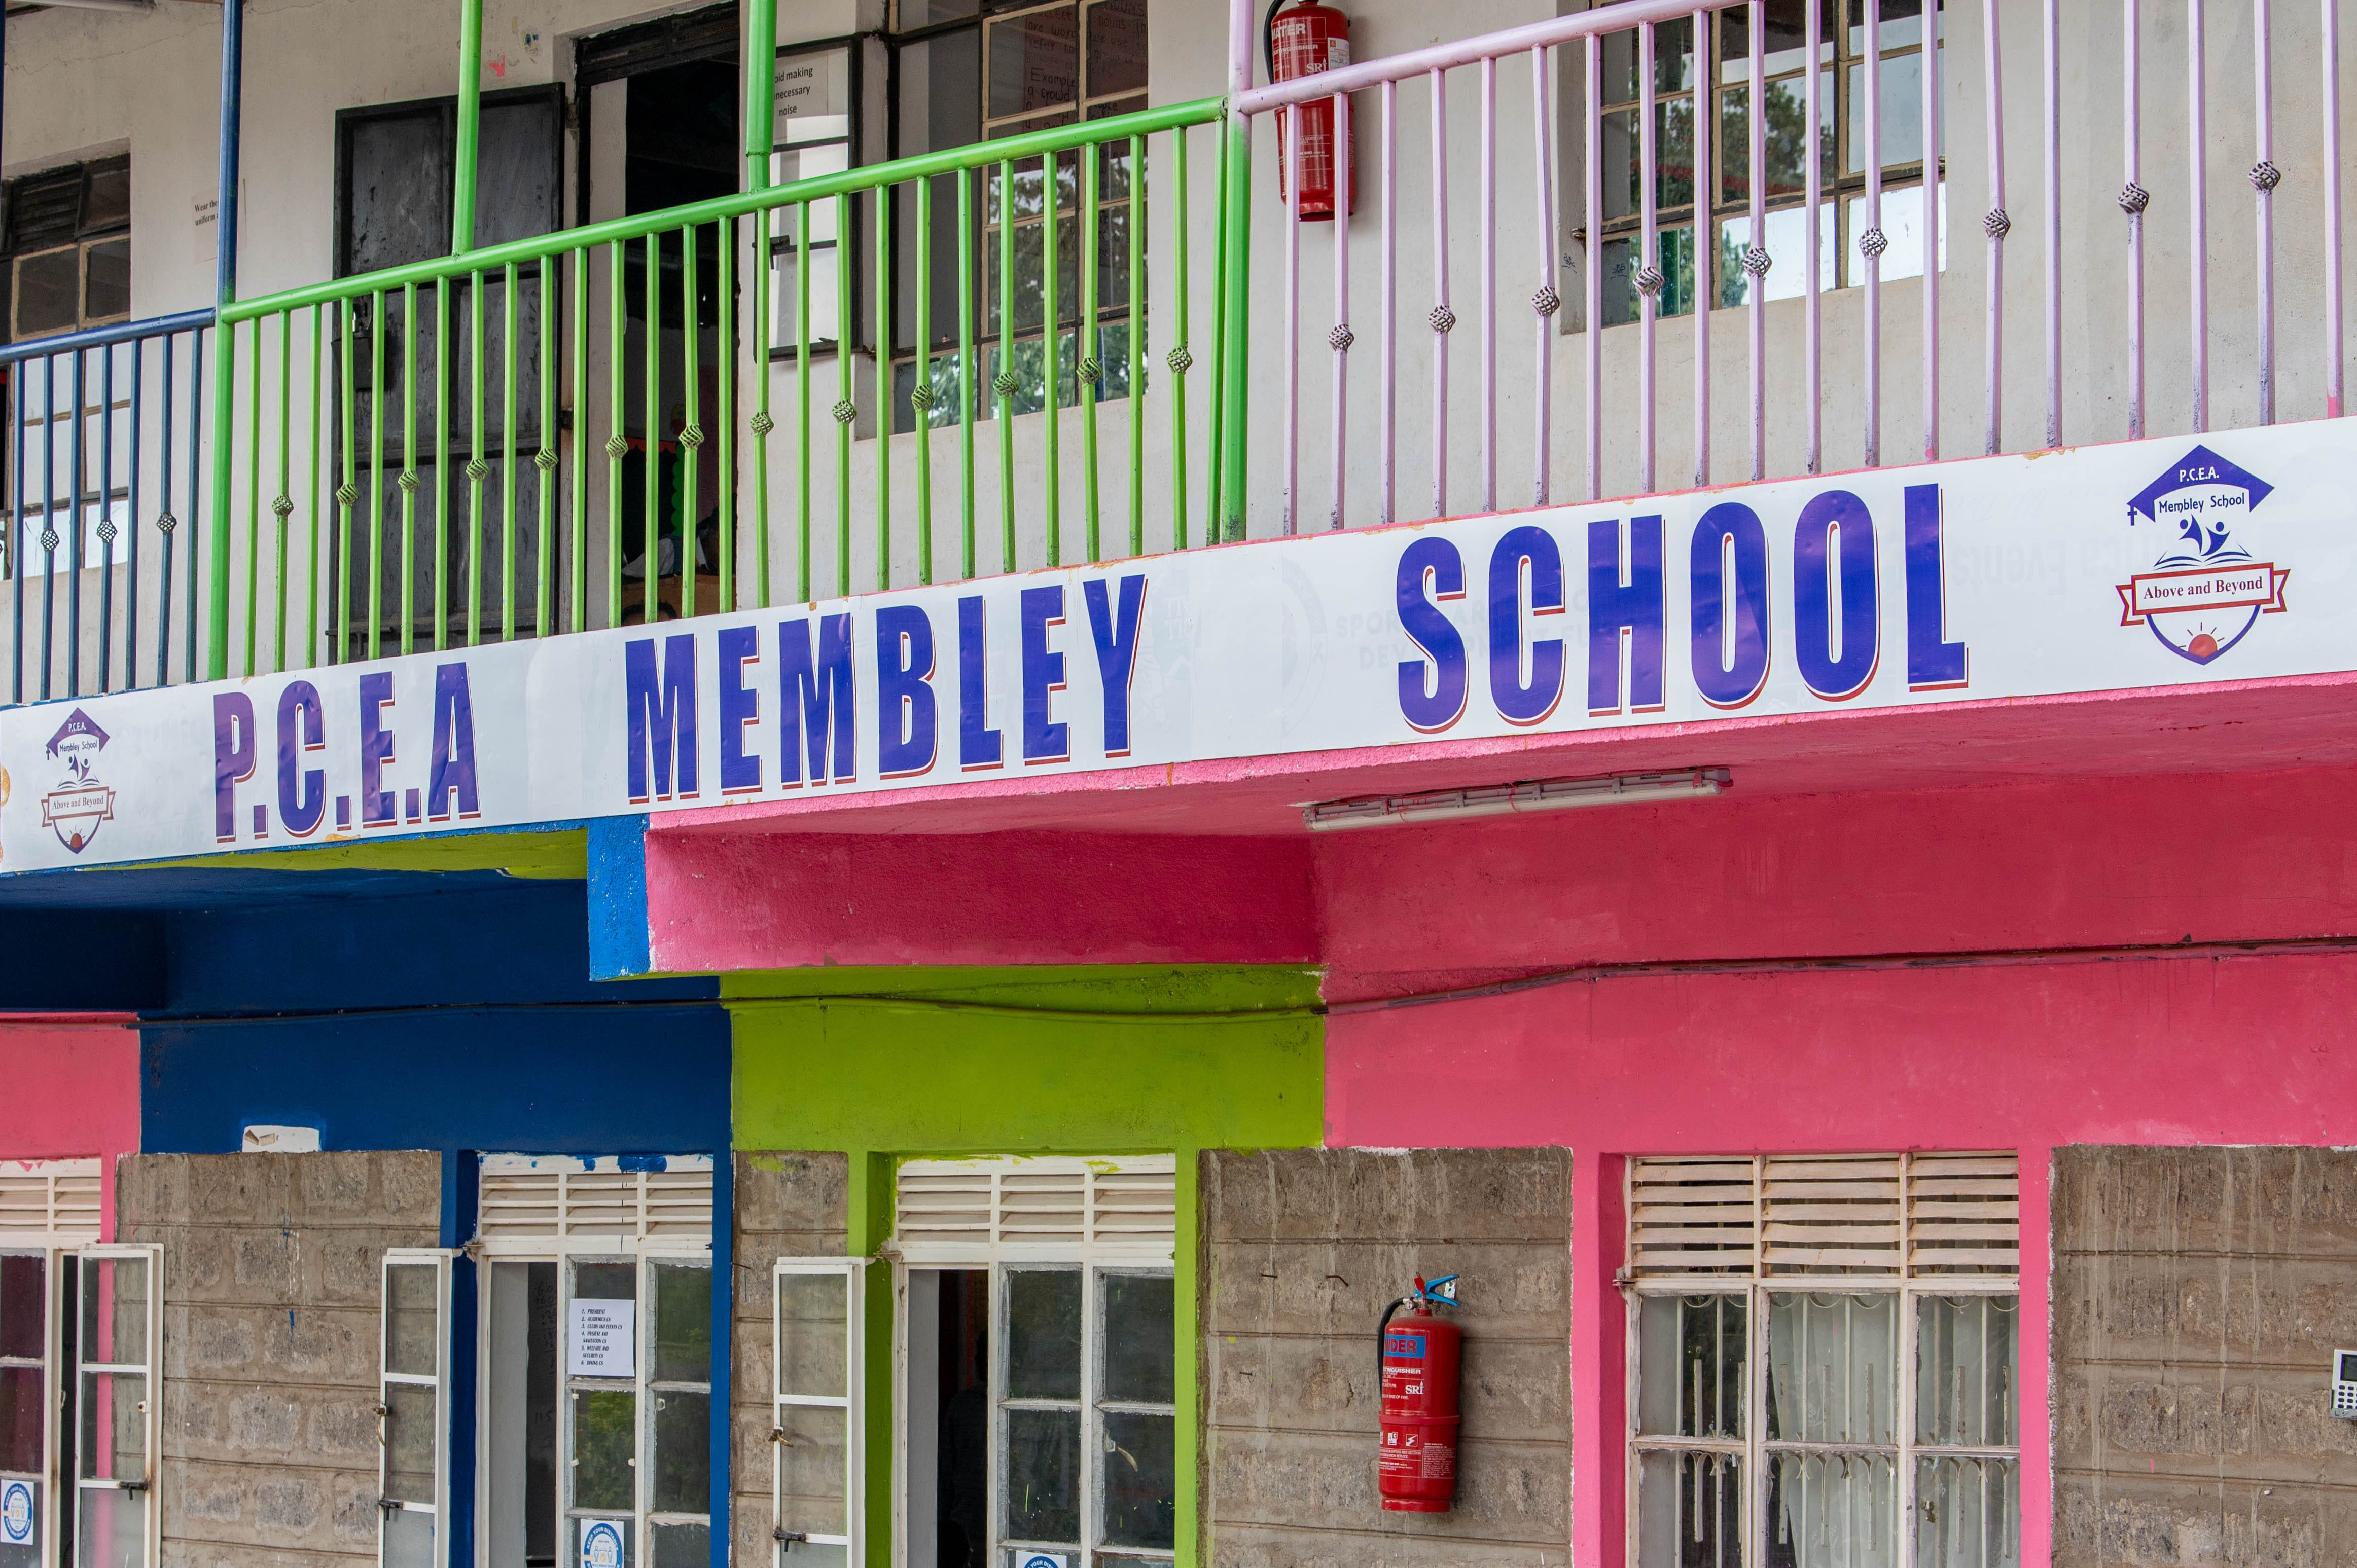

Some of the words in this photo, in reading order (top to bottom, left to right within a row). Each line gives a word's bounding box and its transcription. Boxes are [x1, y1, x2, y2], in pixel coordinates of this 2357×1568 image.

[774, 71, 784, 83] oid
[786, 67, 813, 80] making
[774, 86, 810, 100] necessary
[779, 105, 797, 116] noise
[195, 203, 208, 212] Wear
[195, 214, 215, 226] uniform
[2180, 466, 2219, 482] P.C.E.A.
[2159, 498, 2204, 513] Membley
[2210, 493, 2245, 508] School
[2144, 585, 2184, 599] Above
[2188, 581, 2211, 595] and
[2215, 576, 2263, 596] Beyond
[623, 573, 1149, 805] MEMBLEY
[1395, 482, 1970, 734] SCHOOL
[59, 741, 80, 753] Membley
[82, 739, 98, 751] School
[52, 796, 69, 810] Above
[70, 797, 81, 808] and
[82, 794, 104, 809] Beyond
[1385, 1339, 1416, 1354] WDER
[1405, 1381, 1424, 1394] SRI
[593, 1527, 603, 1535] YOUR
